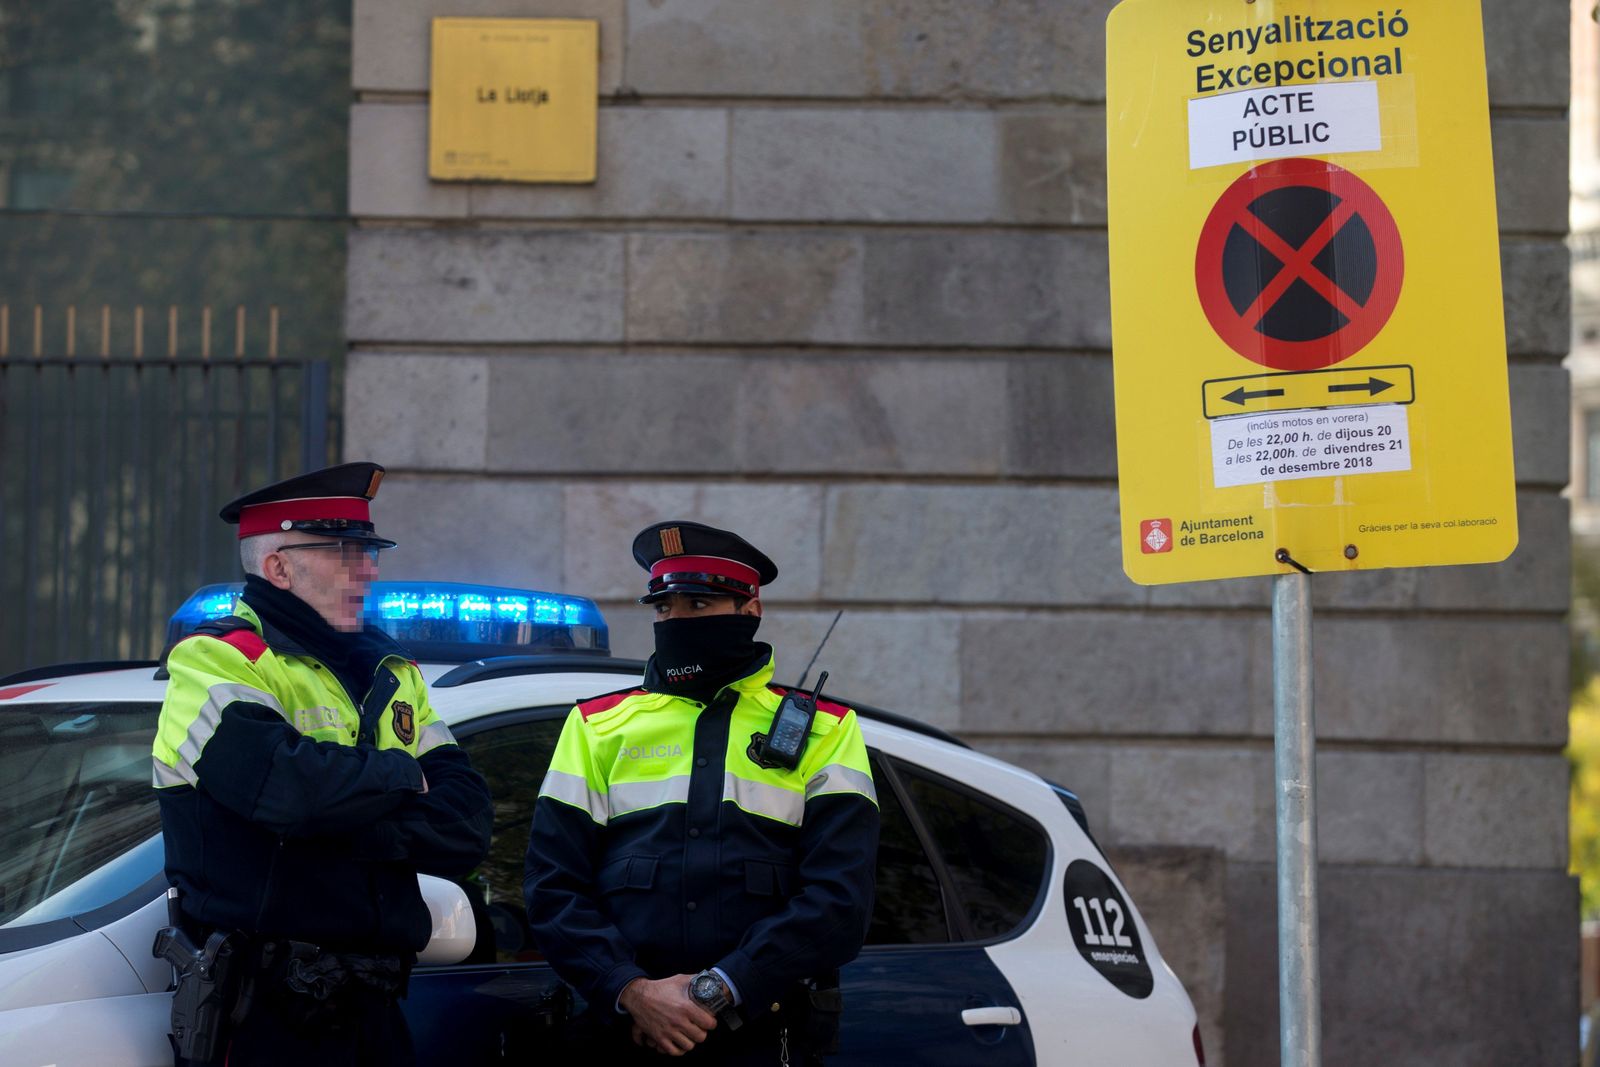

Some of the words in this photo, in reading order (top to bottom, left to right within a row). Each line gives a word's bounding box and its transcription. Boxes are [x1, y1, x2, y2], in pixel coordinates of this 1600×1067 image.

[1186, 9, 1409, 58] Senyalització
[1196, 47, 1403, 93] Excepcional
[1242, 91, 1315, 119] ACTE
[1232, 121, 1331, 151] PÚBLIC
[1247, 419, 1279, 432] (inclús
[1282, 418, 1313, 428] motos
[1316, 416, 1329, 425] en
[1332, 412, 1369, 423] vorera)
[1227, 439, 1243, 450] De
[1246, 437, 1263, 447] les
[1266, 432, 1299, 445] 22,00
[1302, 431, 1313, 442] h.
[1317, 430, 1332, 440] de
[1335, 428, 1374, 441] dijous
[1377, 425, 1392, 436] 20
[1225, 456, 1233, 465] a
[1236, 453, 1252, 464] les
[1302, 446, 1317, 457] de
[1324, 441, 1386, 455] divendres
[1389, 439, 1403, 450] 21
[1260, 465, 1275, 476] de
[1279, 460, 1340, 474] desembre
[1344, 456, 1373, 469] 2018
[1180, 515, 1254, 534] Ajuntament
[1394, 523, 1408, 533] per
[1410, 521, 1418, 530] la
[1420, 521, 1441, 530] seva
[1180, 535, 1196, 546] de
[1200, 530, 1264, 544] Barcelona
[666, 664, 703, 677] POLICIA
[618, 743, 685, 760] POLICIA
[1073, 896, 1133, 948] 112
